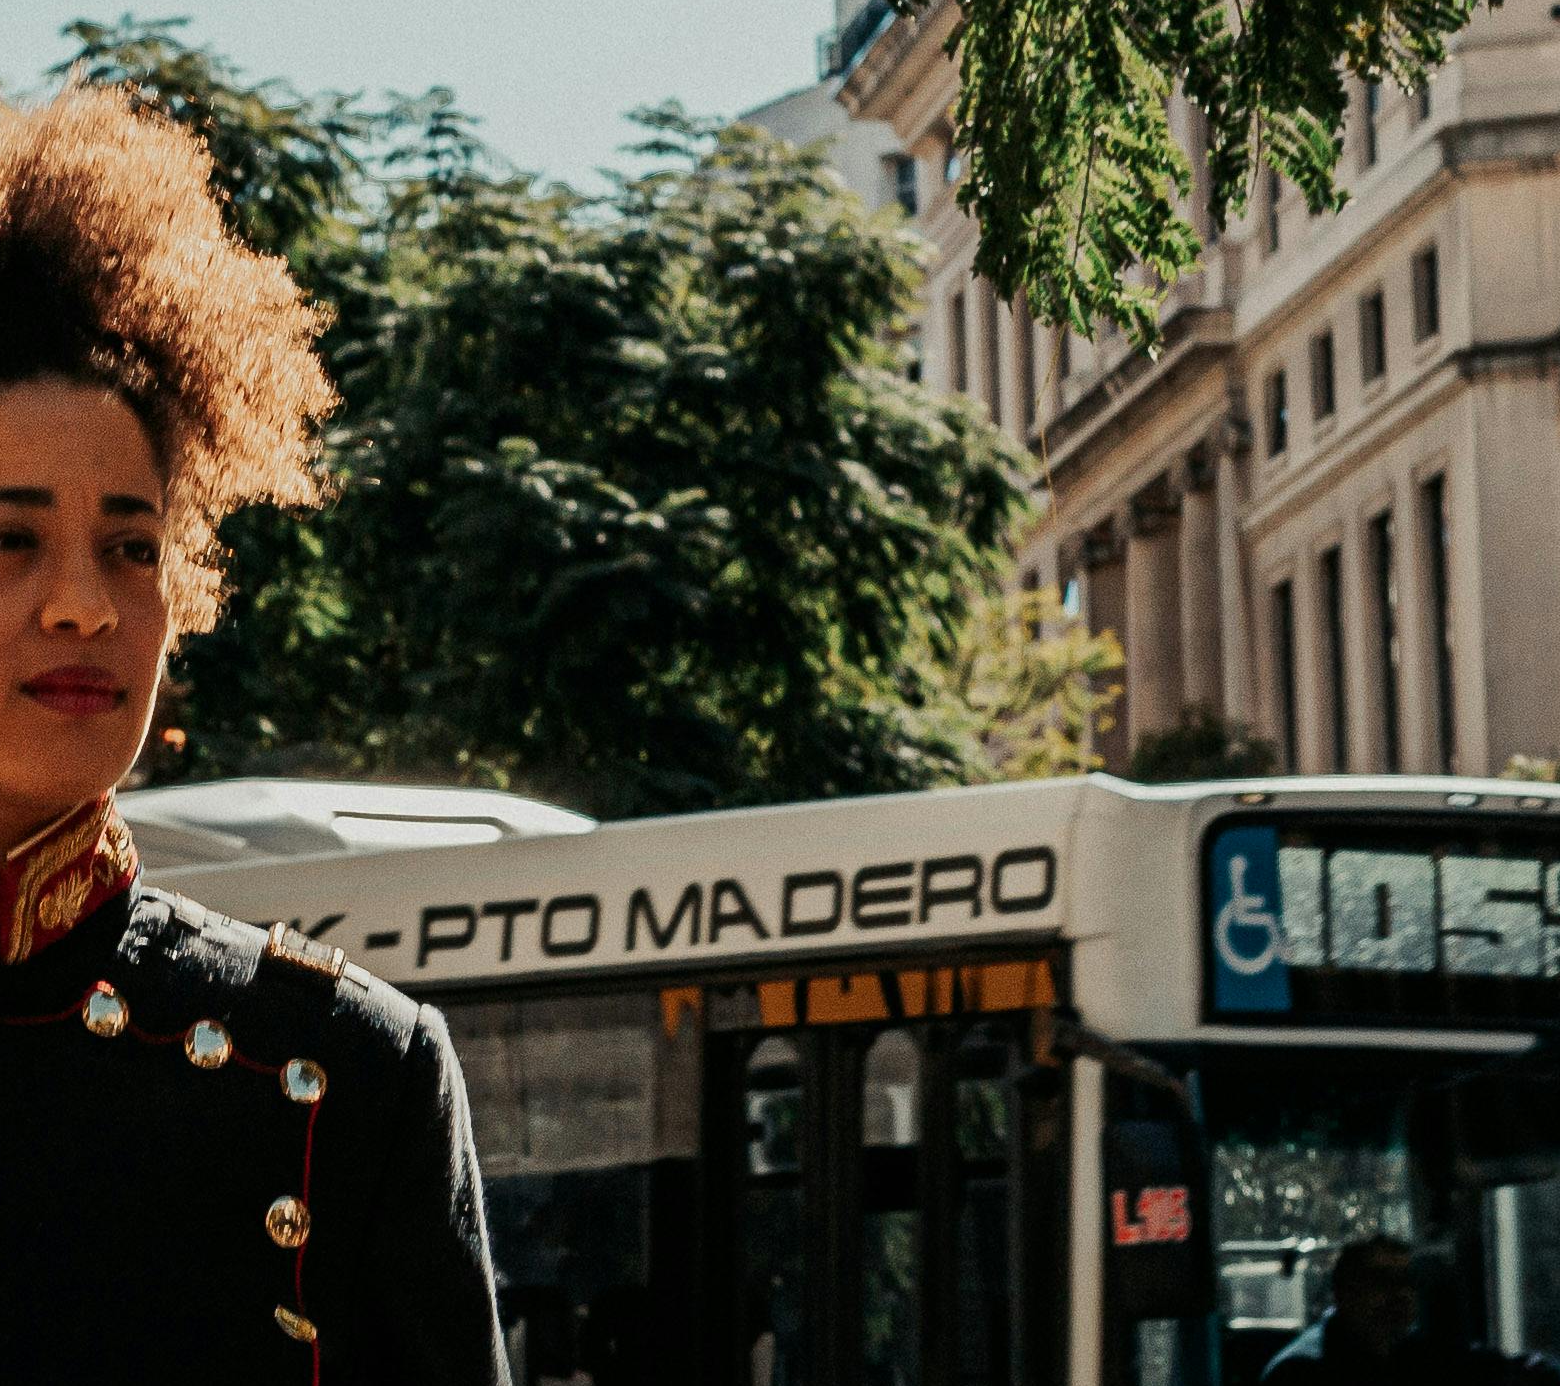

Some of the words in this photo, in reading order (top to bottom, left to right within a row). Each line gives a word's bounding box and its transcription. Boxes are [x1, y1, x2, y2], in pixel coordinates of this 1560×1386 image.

[415, 892, 602, 968] PTO
[625, 844, 1058, 953] MADERO
[1277, 846, 1543, 977] 105
